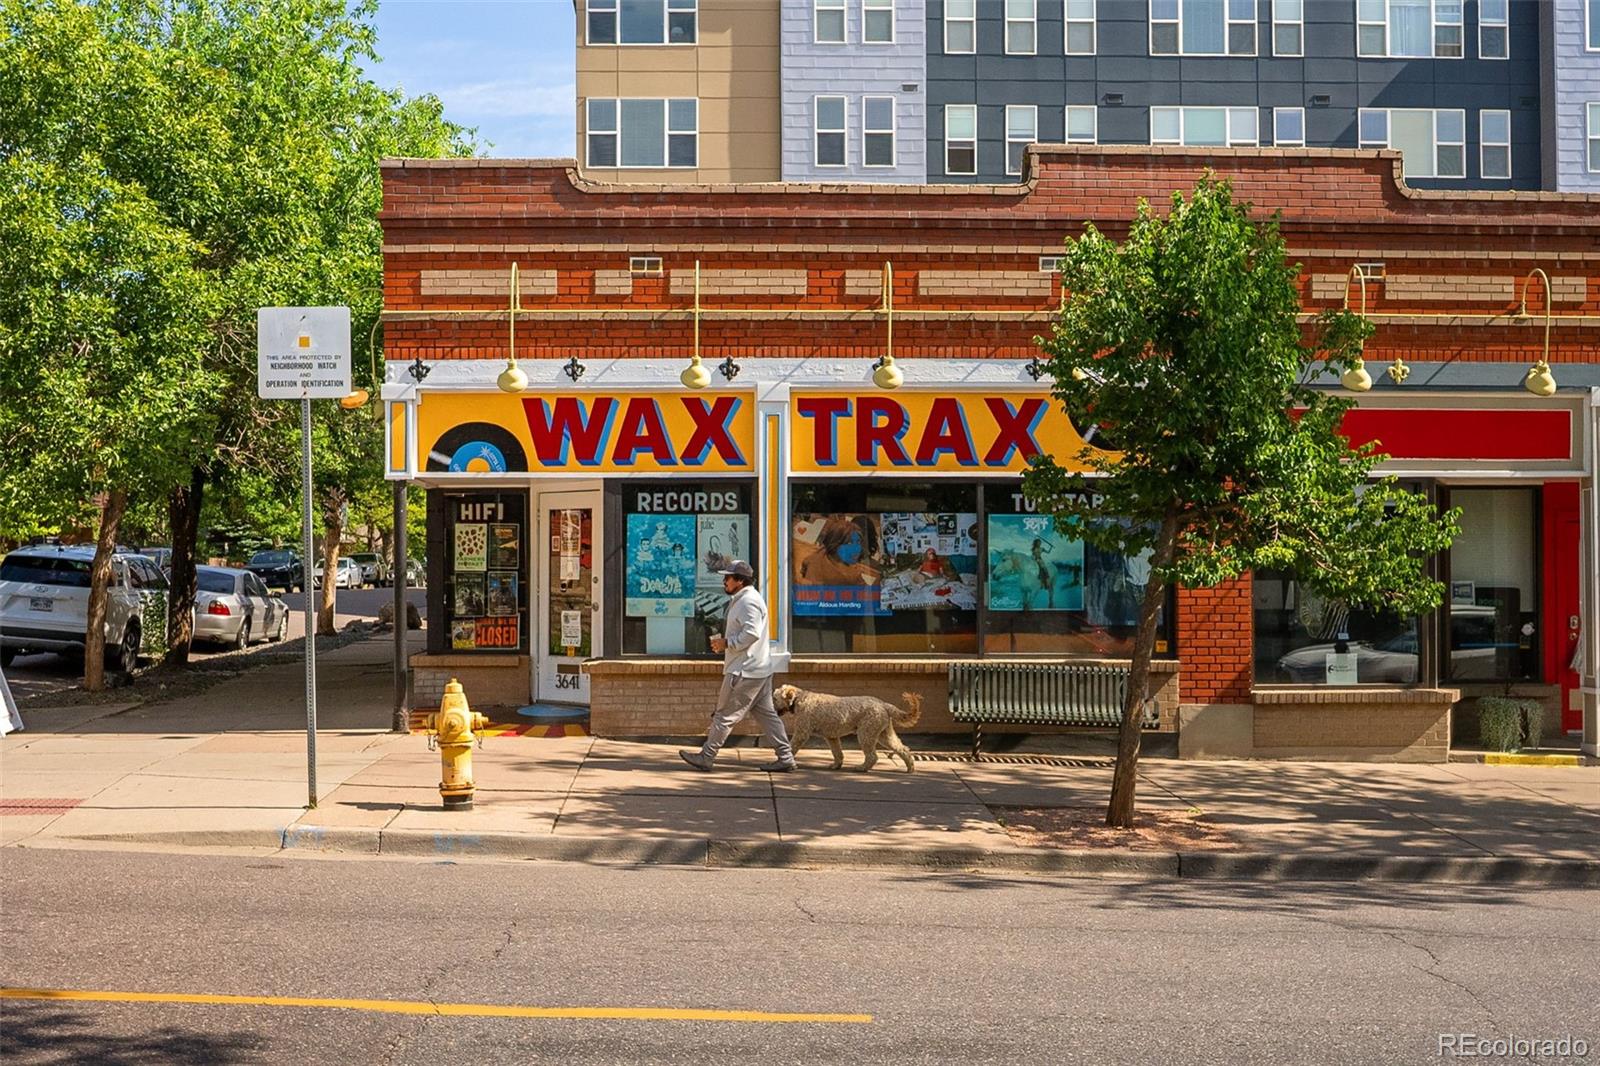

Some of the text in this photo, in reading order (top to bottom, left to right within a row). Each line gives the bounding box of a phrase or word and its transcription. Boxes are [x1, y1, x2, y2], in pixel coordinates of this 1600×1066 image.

[270, 362, 313, 370] NEIGHBORHOOD
[265, 380, 344, 388] OPERATION IDENTIFICATION
[521, 397, 1050, 466] WAX TRAX
[637, 492, 739, 512] RECORDS
[461, 503, 504, 520] HIFI
[838, 601, 862, 609] Harding
[476, 626, 517, 646] CLOSED
[555, 674, 580, 690] 3641
